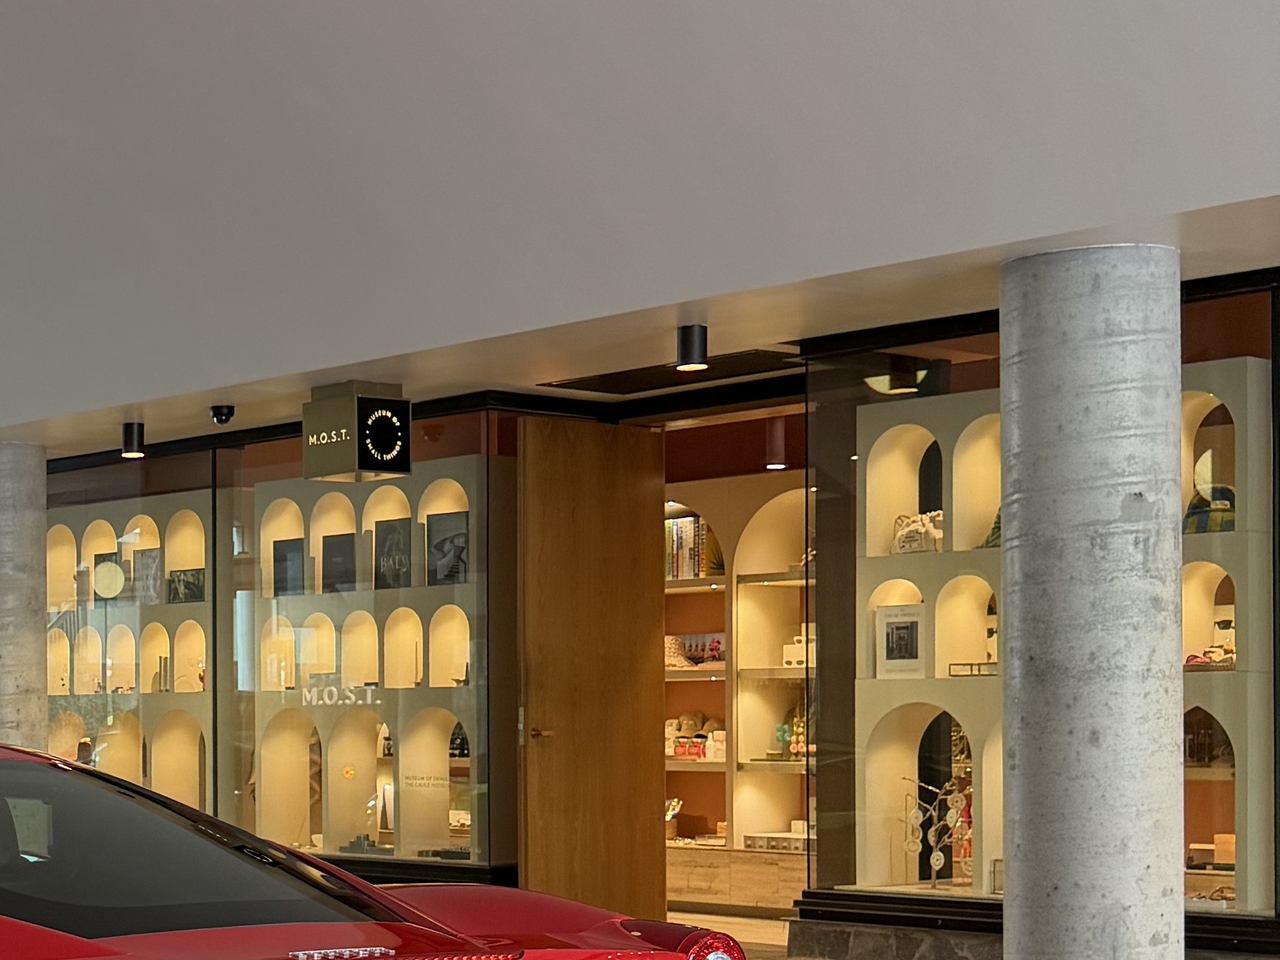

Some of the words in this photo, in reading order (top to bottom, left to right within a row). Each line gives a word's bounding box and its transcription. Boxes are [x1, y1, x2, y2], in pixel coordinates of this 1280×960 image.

[367, 409, 392, 426] MUSEUM
[308, 429, 350, 445] M.O.S.T.
[365, 438, 381, 460] SMALL
[383, 440, 402, 461] THINGS
[302, 686, 381, 705] M.O.S.T.
